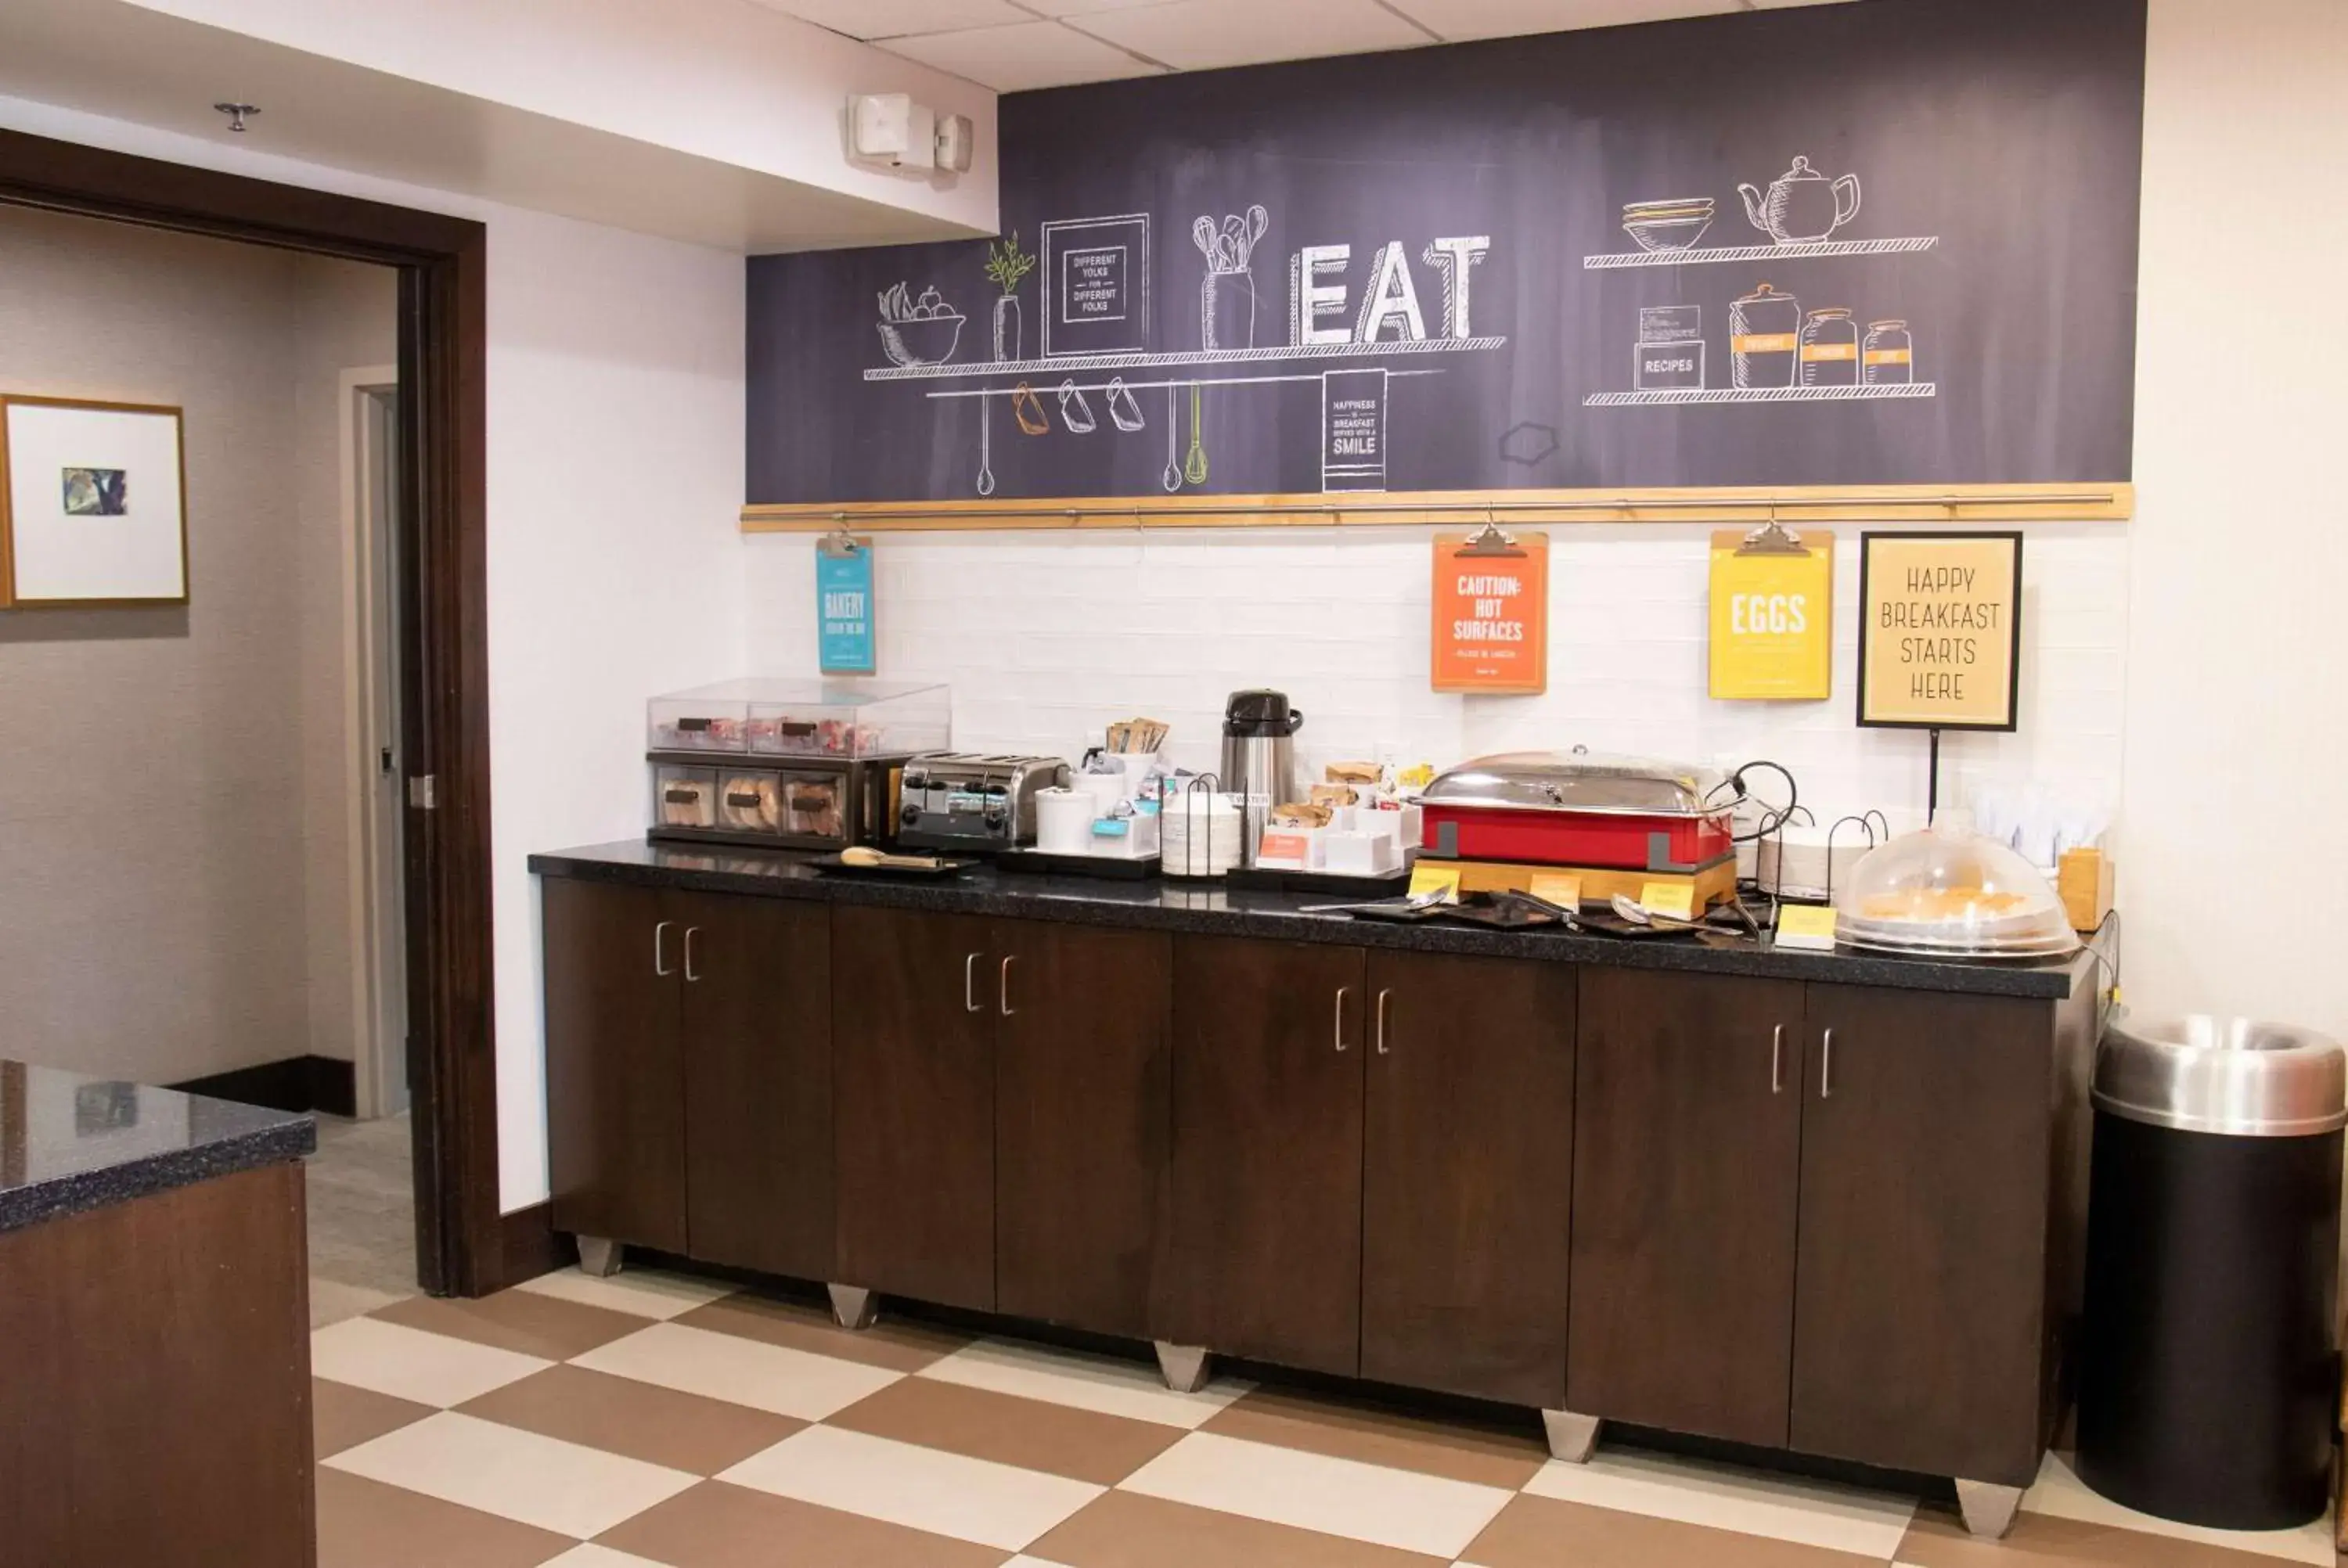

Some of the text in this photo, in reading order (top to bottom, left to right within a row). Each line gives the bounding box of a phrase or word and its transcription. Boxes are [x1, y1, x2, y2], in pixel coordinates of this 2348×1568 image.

[1073, 254, 1117, 268] DIFFERENT
[1082, 267, 1108, 278] YOLKS
[1073, 289, 1117, 301] DIFFERENT
[1290, 236, 1490, 347] EAT
[1082, 301, 1108, 312] FOLKS
[1645, 359, 1693, 373] RECIPES
[1333, 400, 1376, 410] HAPPINESS
[1333, 419, 1375, 428] BREAKFAST
[1333, 437, 1376, 455] SMILE
[1457, 575, 1522, 595] CAUTION:
[1907, 566, 1975, 594] HAPPY
[825, 592, 865, 619] BAKERY
[1475, 599, 1503, 618] HOT
[1731, 593, 1807, 635] EGGS
[1881, 602, 2001, 630] BREAKFAST
[1453, 620, 1523, 641] SURFACES
[1900, 637, 1977, 664] STARTS
[1910, 672, 1964, 700] HERE
